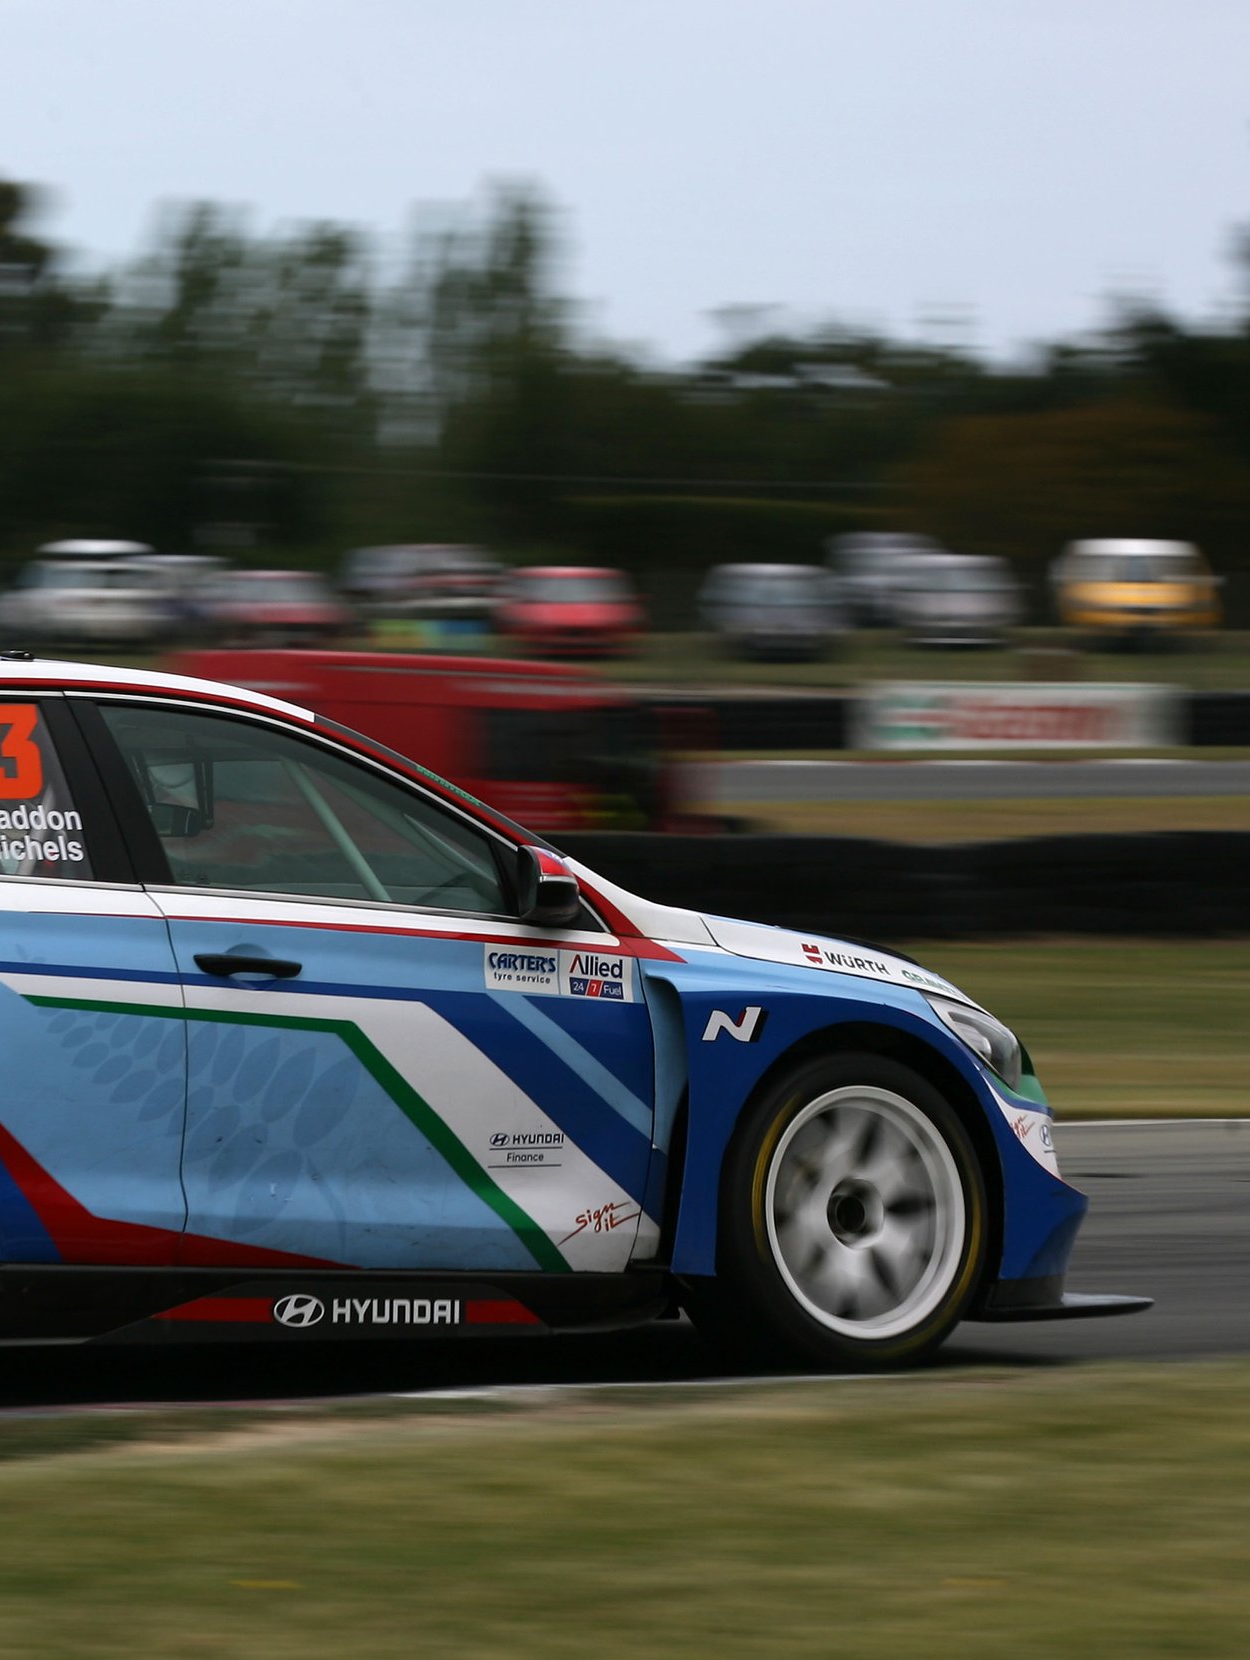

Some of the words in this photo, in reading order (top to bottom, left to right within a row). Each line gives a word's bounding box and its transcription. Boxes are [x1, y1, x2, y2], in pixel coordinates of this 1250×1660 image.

[569, 954, 624, 979] Allied
[493, 972, 513, 981] tyre
[516, 975, 551, 984] service
[573, 980, 585, 992] 24
[603, 983, 623, 996] Fuel
[512, 1133, 564, 1145] HYUNDAI
[506, 1153, 544, 1163] Finance
[332, 1299, 460, 1324] HYUNDAI
